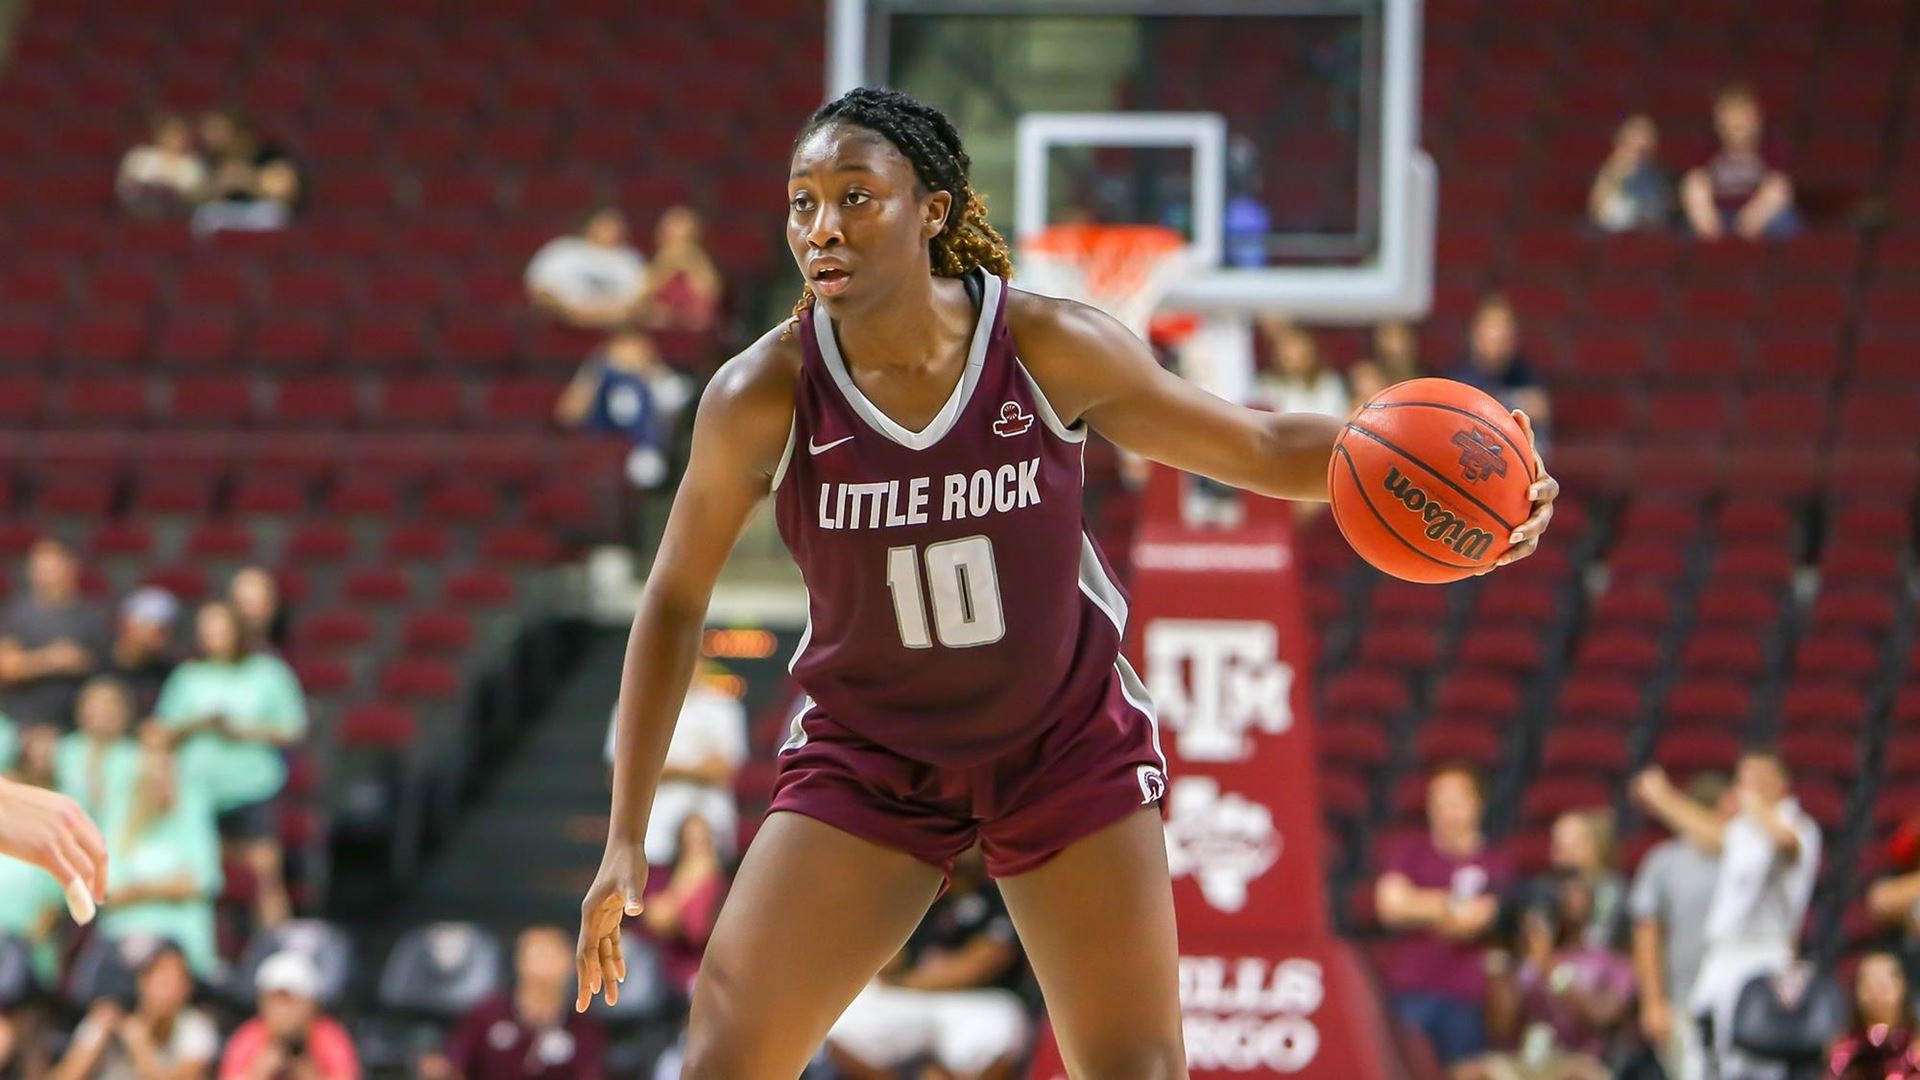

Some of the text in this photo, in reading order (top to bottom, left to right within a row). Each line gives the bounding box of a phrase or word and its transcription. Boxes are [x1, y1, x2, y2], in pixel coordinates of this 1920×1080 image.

[818, 457, 1042, 529] LITTLE ROCK
[1383, 465, 1494, 561] Wilson
[886, 534, 1006, 649] 10
[1178, 956, 1325, 1014] ELLS
